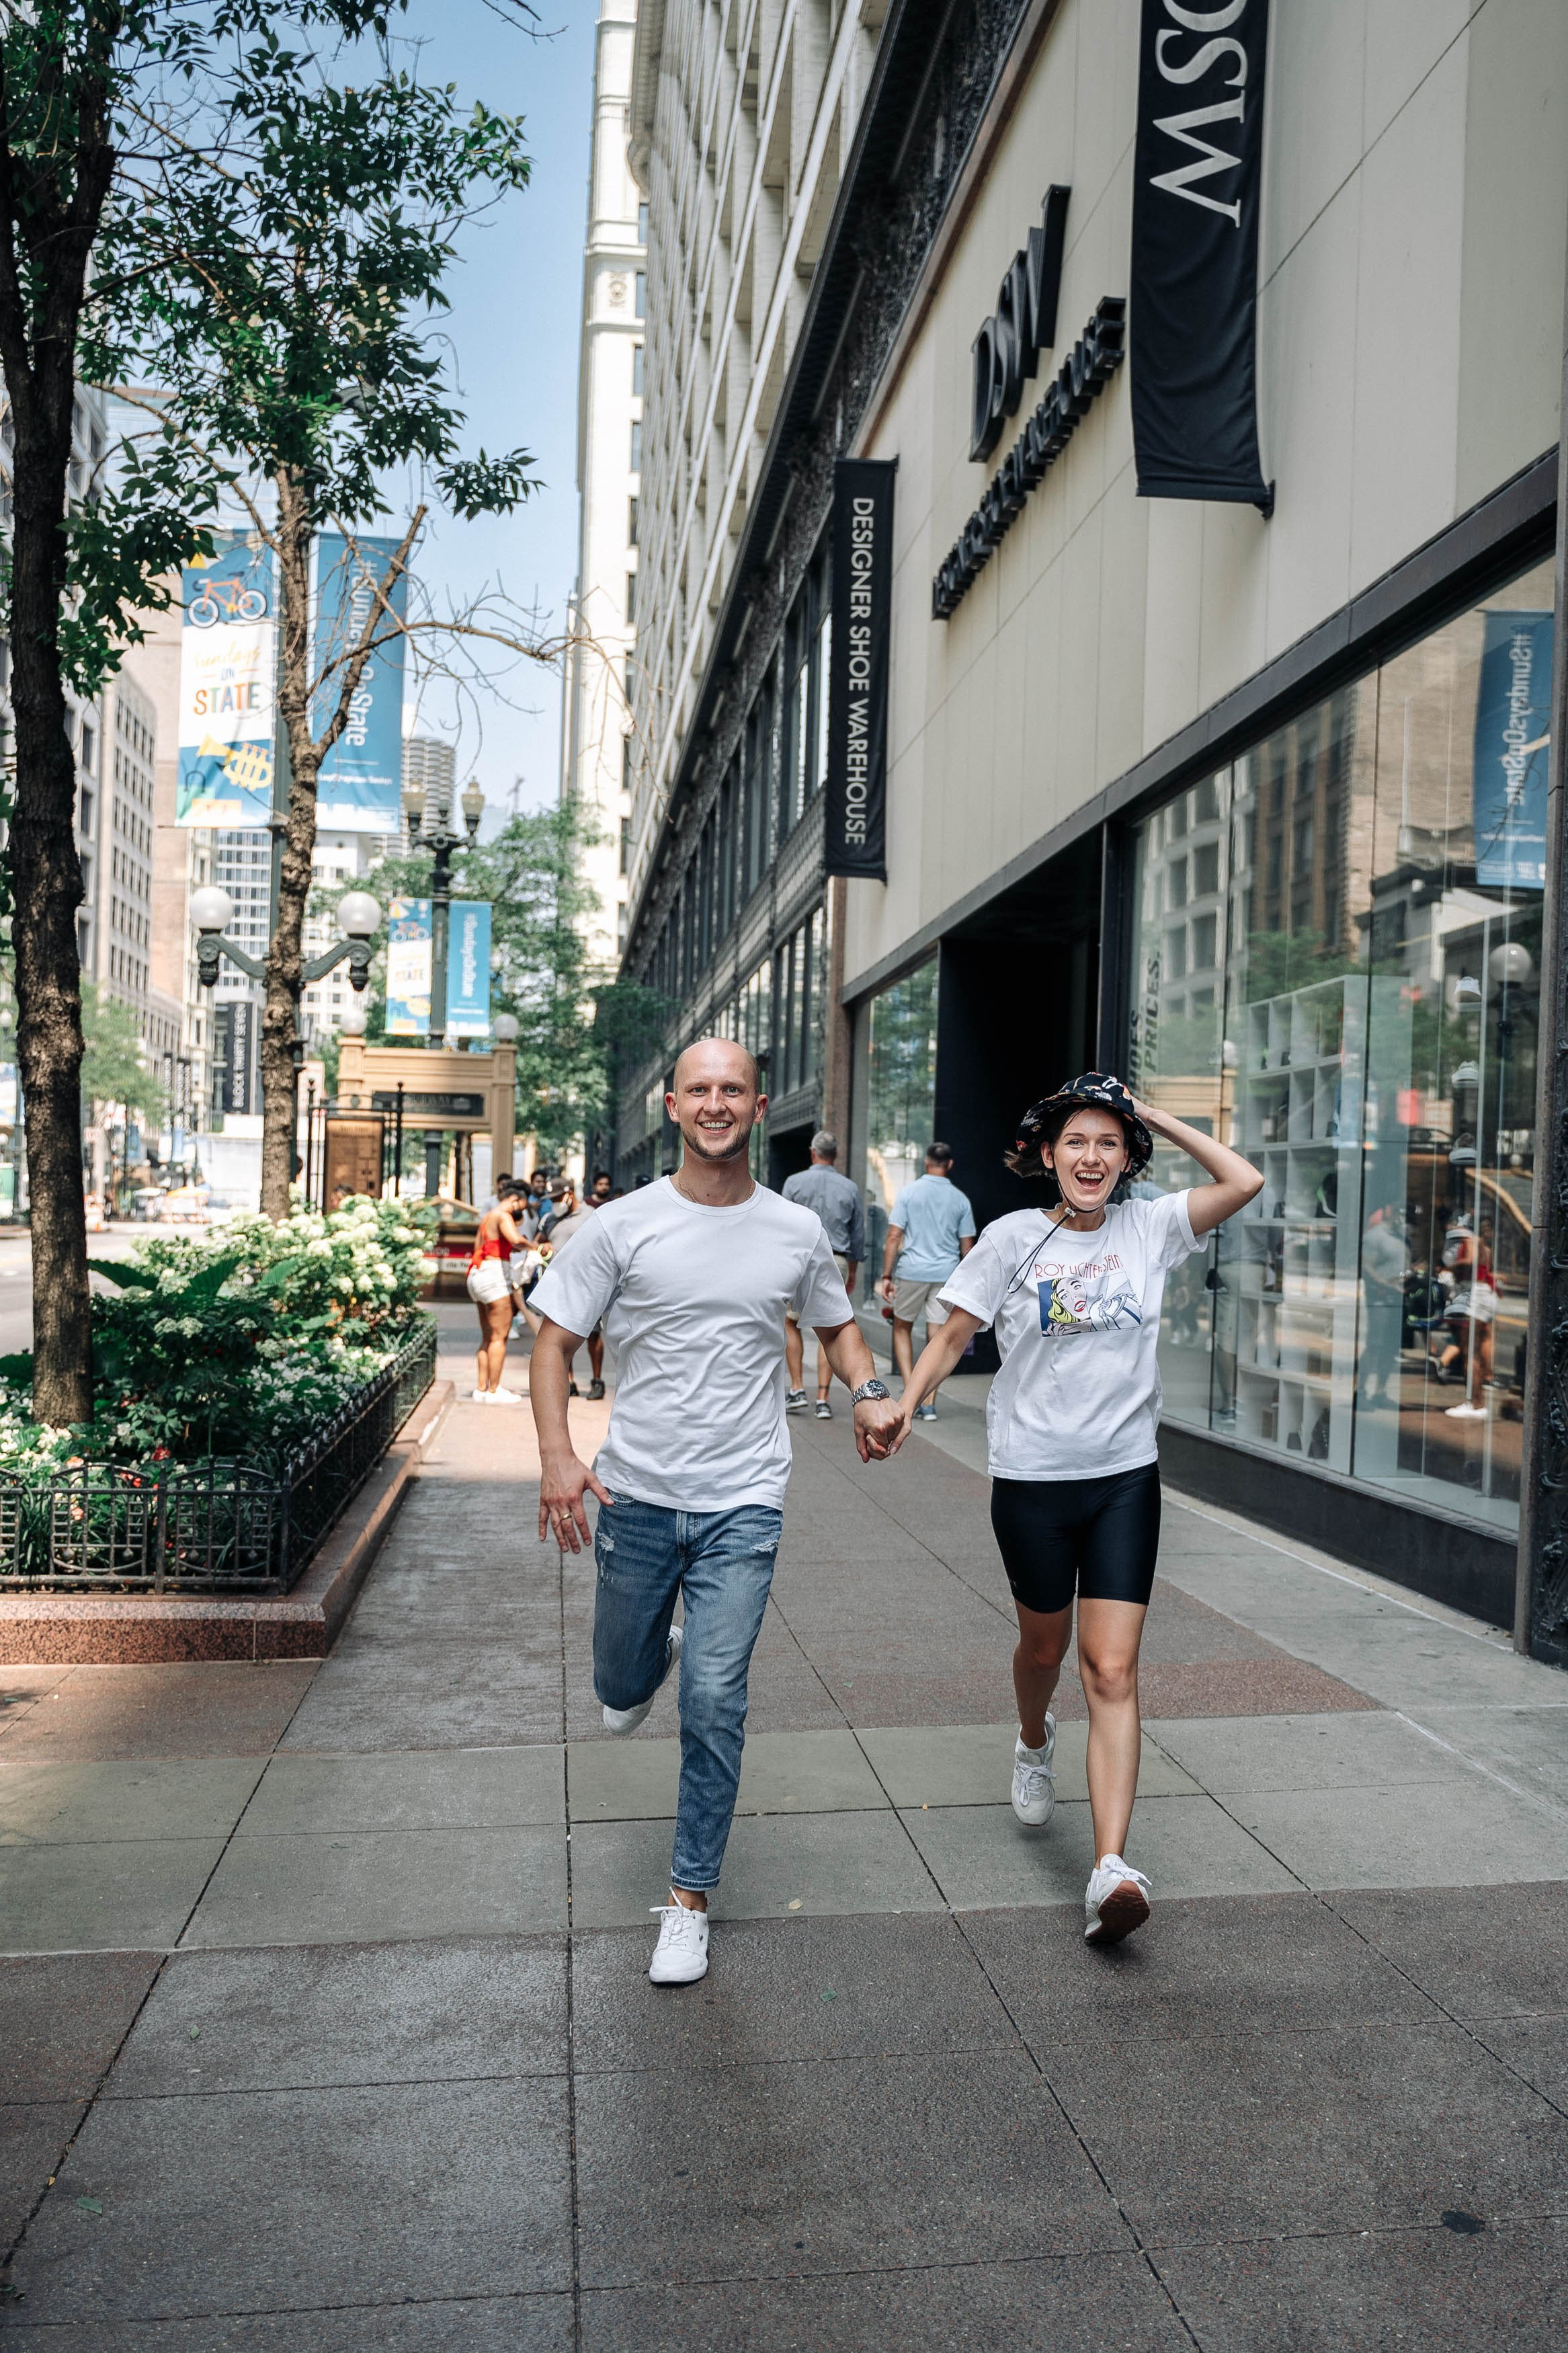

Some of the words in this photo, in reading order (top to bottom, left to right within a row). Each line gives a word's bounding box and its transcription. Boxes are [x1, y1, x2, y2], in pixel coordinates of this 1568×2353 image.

[850, 497, 874, 619] DESIGNER
[848, 625, 871, 691] SHOE
[194, 682, 261, 715] STATE
[845, 697, 869, 844] WAREHOUSE
[234, 1003, 247, 1036] SEVEN
[233, 1037, 246, 1072] THIRTY
[232, 1072, 245, 1108] BLOCK
[1034, 1263, 1065, 1278] ROY
